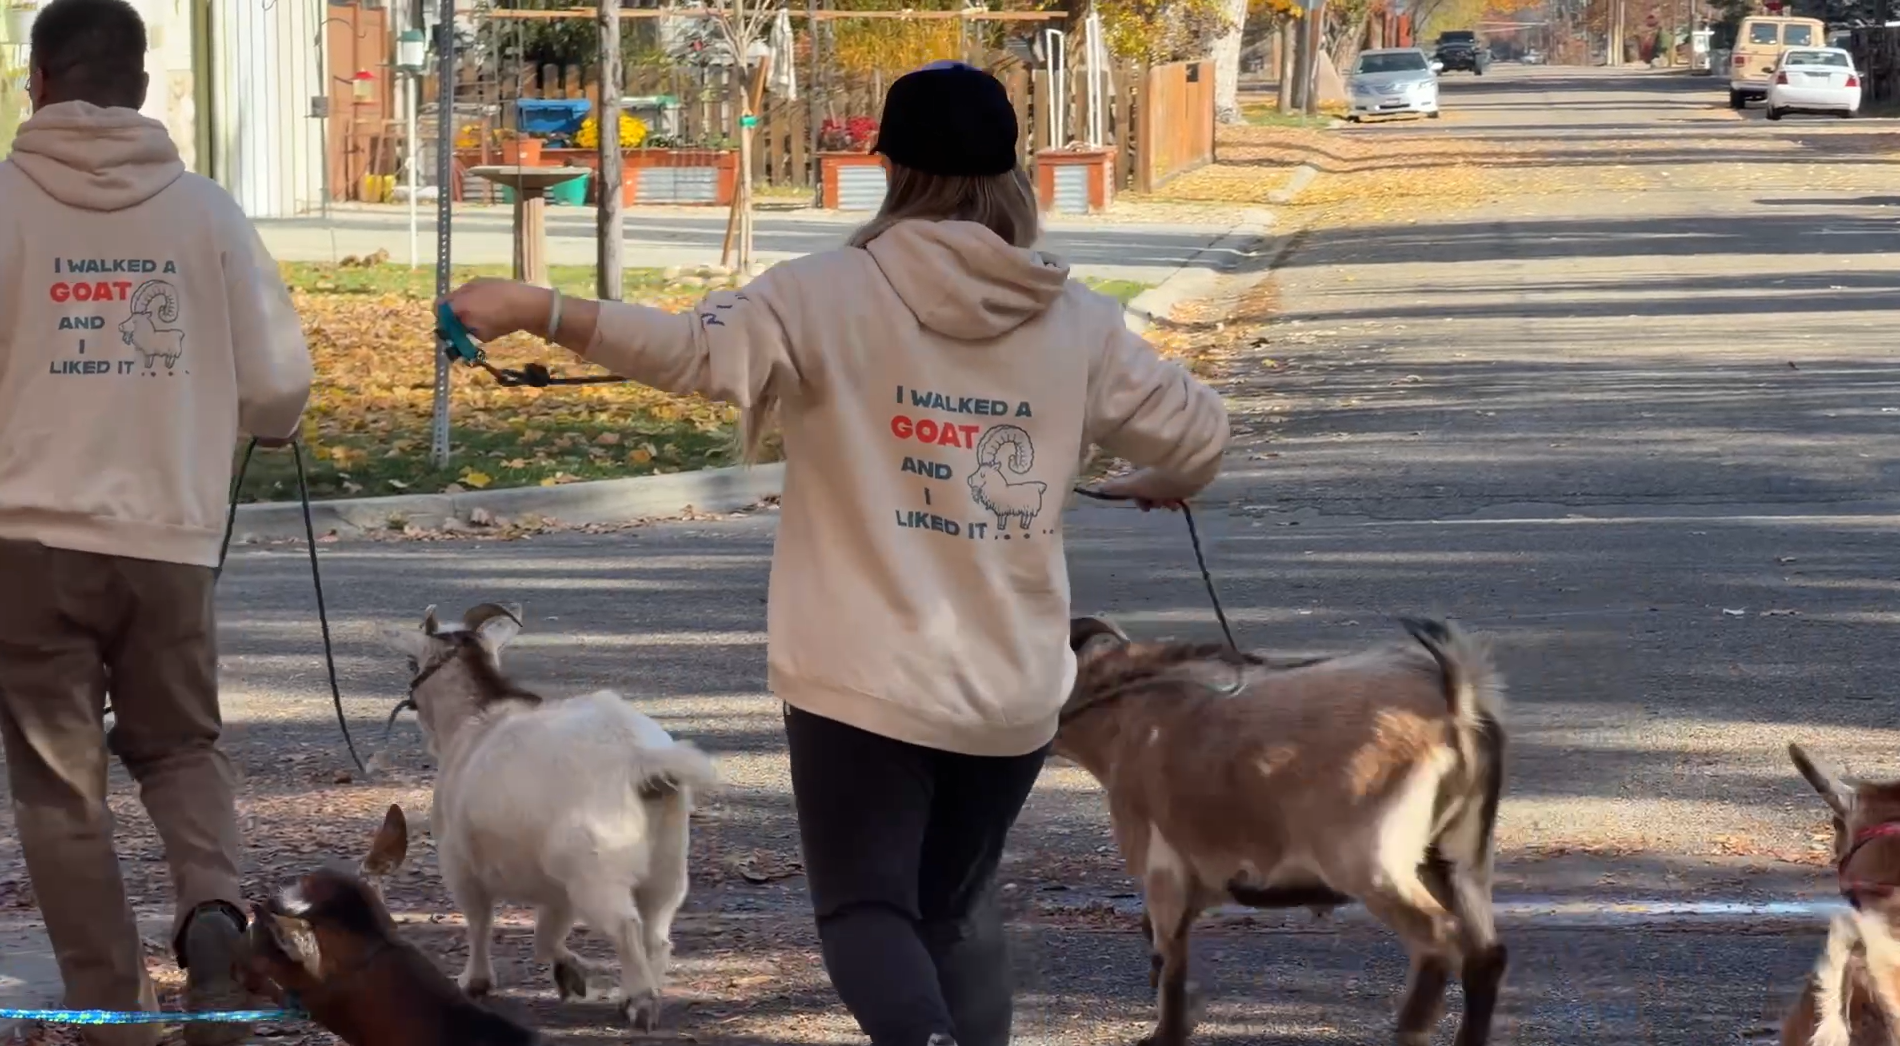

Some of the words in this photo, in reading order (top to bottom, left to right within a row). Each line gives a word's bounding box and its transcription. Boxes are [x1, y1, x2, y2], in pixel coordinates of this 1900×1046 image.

[54, 257, 61, 273] I
[67, 258, 157, 273] WALKED
[162, 260, 177, 274] A
[50, 281, 132, 302] GOAT
[58, 315, 105, 330] AND
[78, 339, 85, 354] I
[49, 360, 111, 374] LIKED
[896, 385, 904, 404] I
[910, 389, 1008, 416] WALKED
[1015, 401, 1033, 418] A
[891, 415, 979, 449] GOAT
[901, 456, 953, 480] AND
[924, 487, 931, 505] I
[895, 510, 960, 537] LIKED
